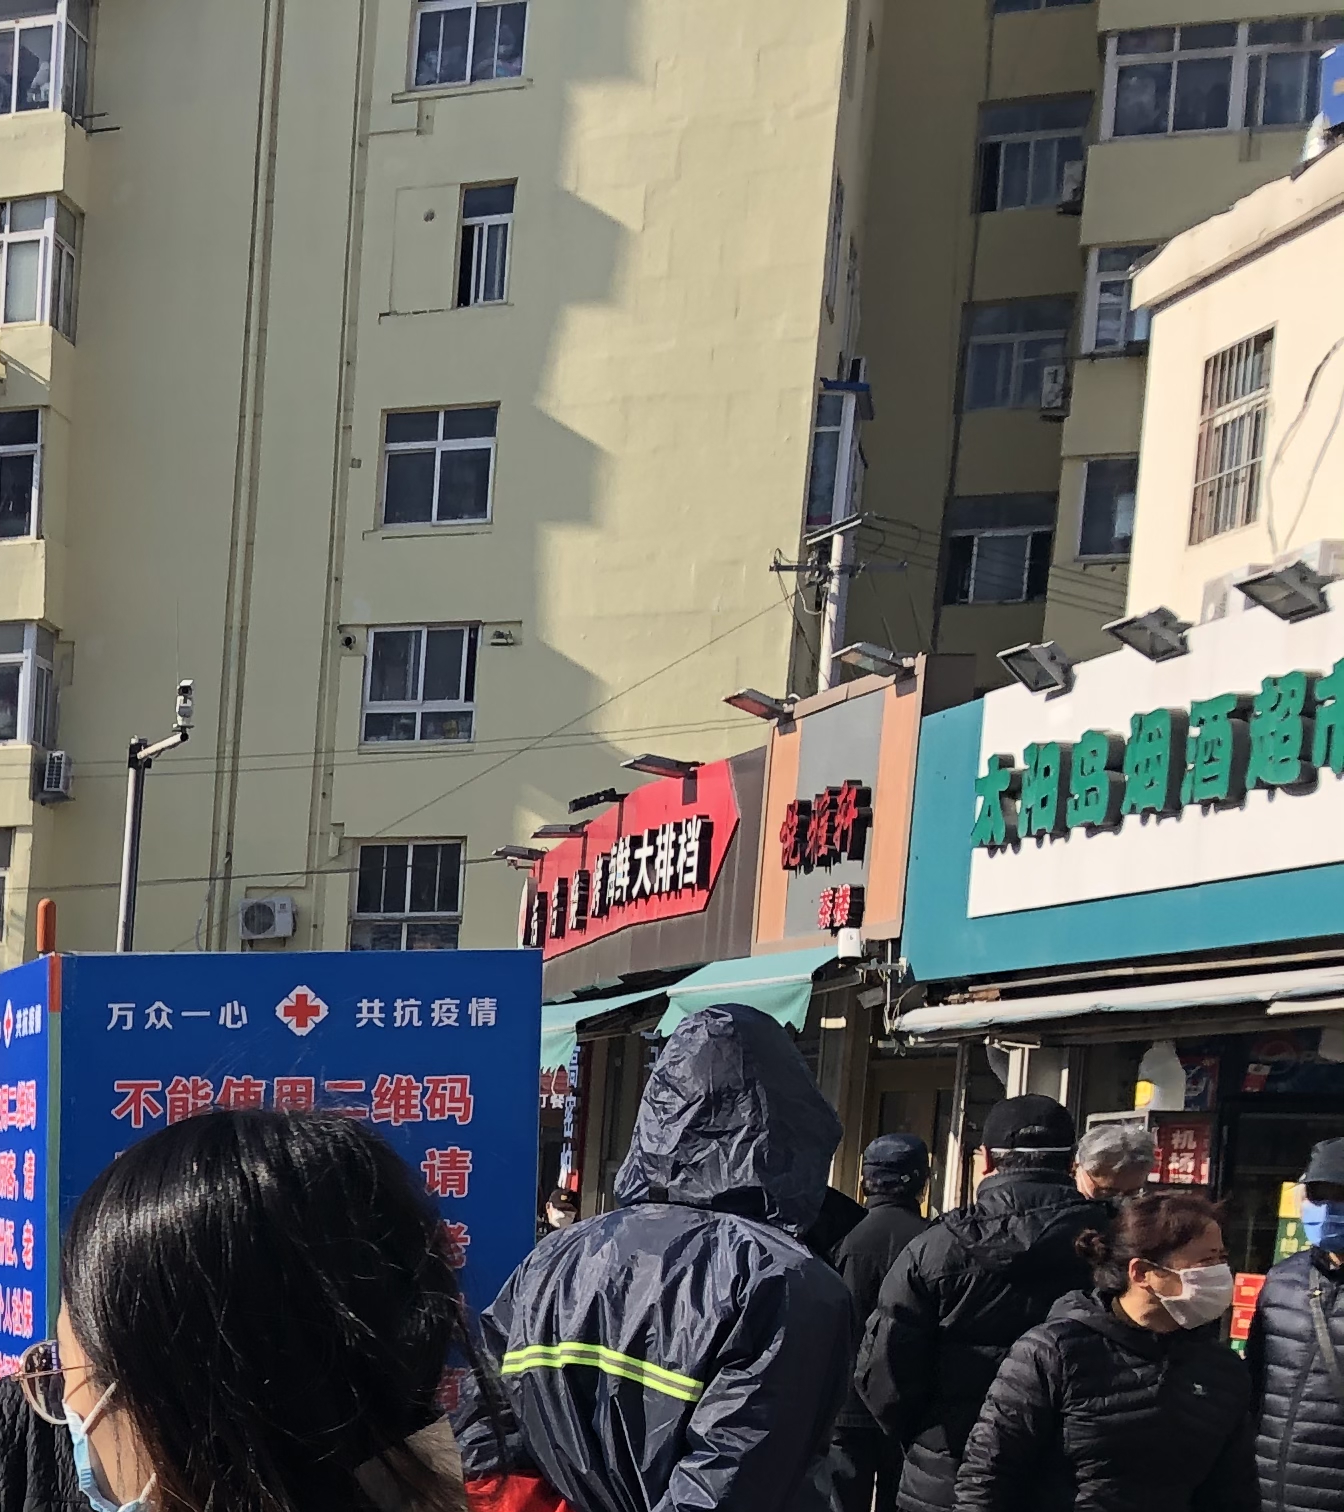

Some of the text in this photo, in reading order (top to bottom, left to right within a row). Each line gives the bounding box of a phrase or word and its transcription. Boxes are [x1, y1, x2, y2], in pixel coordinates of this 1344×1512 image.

[107, 996, 499, 1031] 万众一心 共抗疫情
[111, 1074, 475, 1127] 不能使用二维码
[421, 1146, 473, 1198] 请
